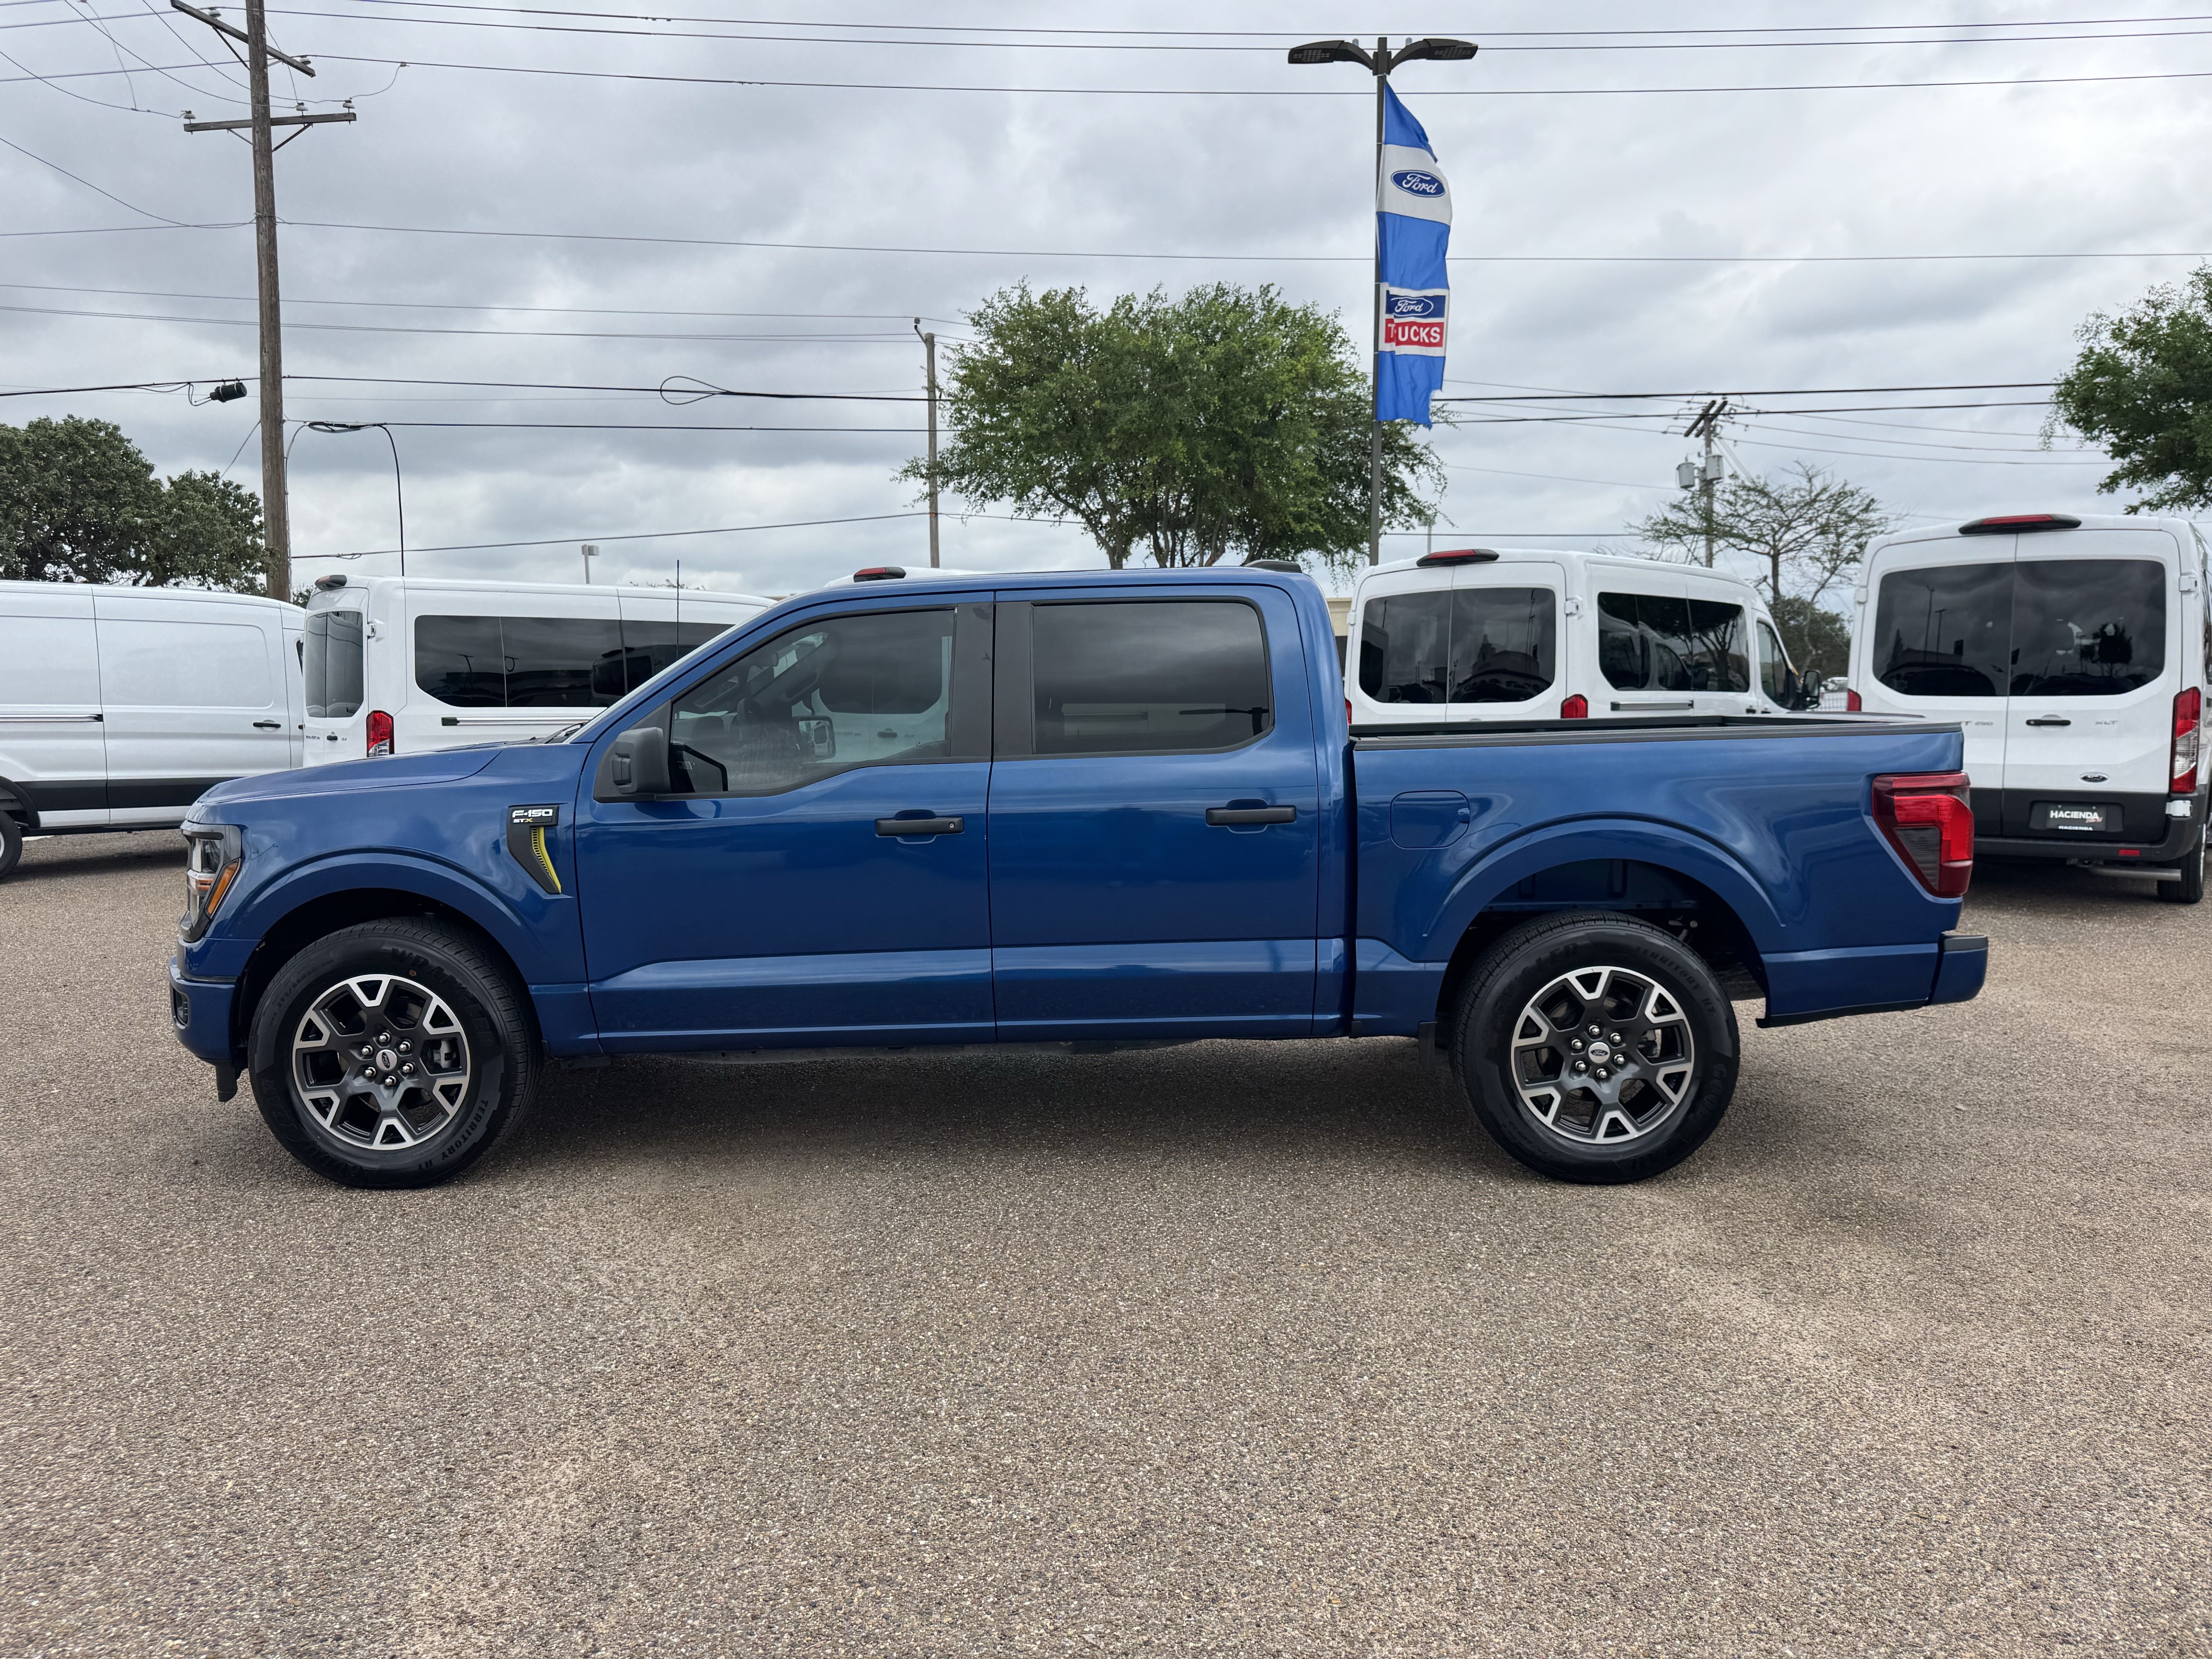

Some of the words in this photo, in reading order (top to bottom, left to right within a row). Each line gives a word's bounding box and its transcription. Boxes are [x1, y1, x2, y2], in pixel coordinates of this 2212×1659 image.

[1402, 173, 1437, 194] Ford
[1395, 300, 1424, 313] Ford
[1388, 324, 1441, 343] TUCKS
[512, 809, 553, 818] F-150
[2050, 810, 2099, 819] HACIENDA
